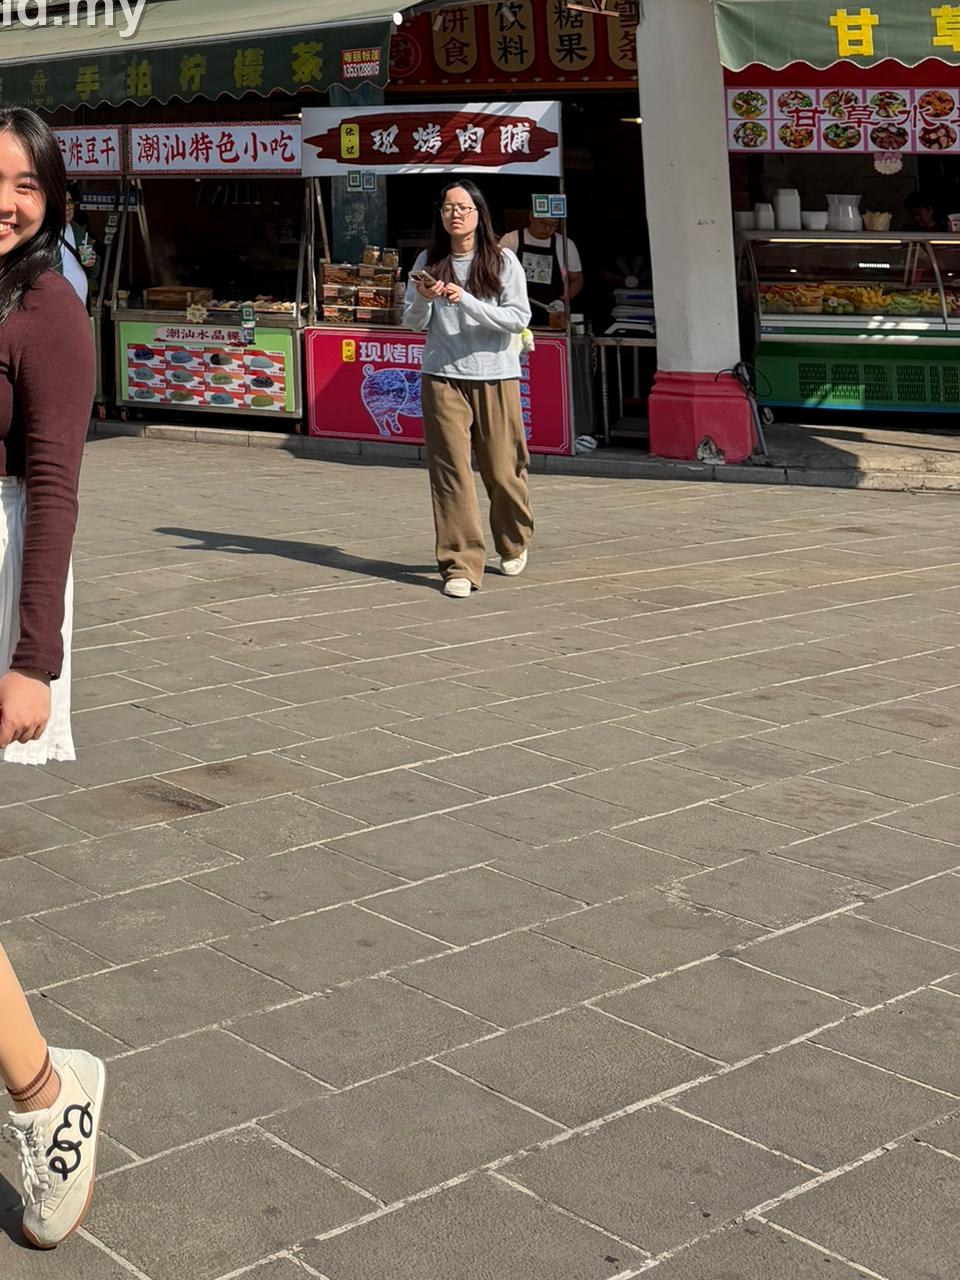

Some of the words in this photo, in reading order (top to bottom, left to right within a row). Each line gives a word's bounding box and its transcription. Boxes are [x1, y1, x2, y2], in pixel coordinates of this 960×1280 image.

[495, 1, 528, 65] 饮料
[553, 0, 588, 64] 糖果
[75, 41, 323, 100] 手拍柠檬茶
[370, 122, 531, 155] 现烤肉脯
[787, 104, 960, 129] 甘草水
[136, 129, 296, 165] 潮汕特色小吃
